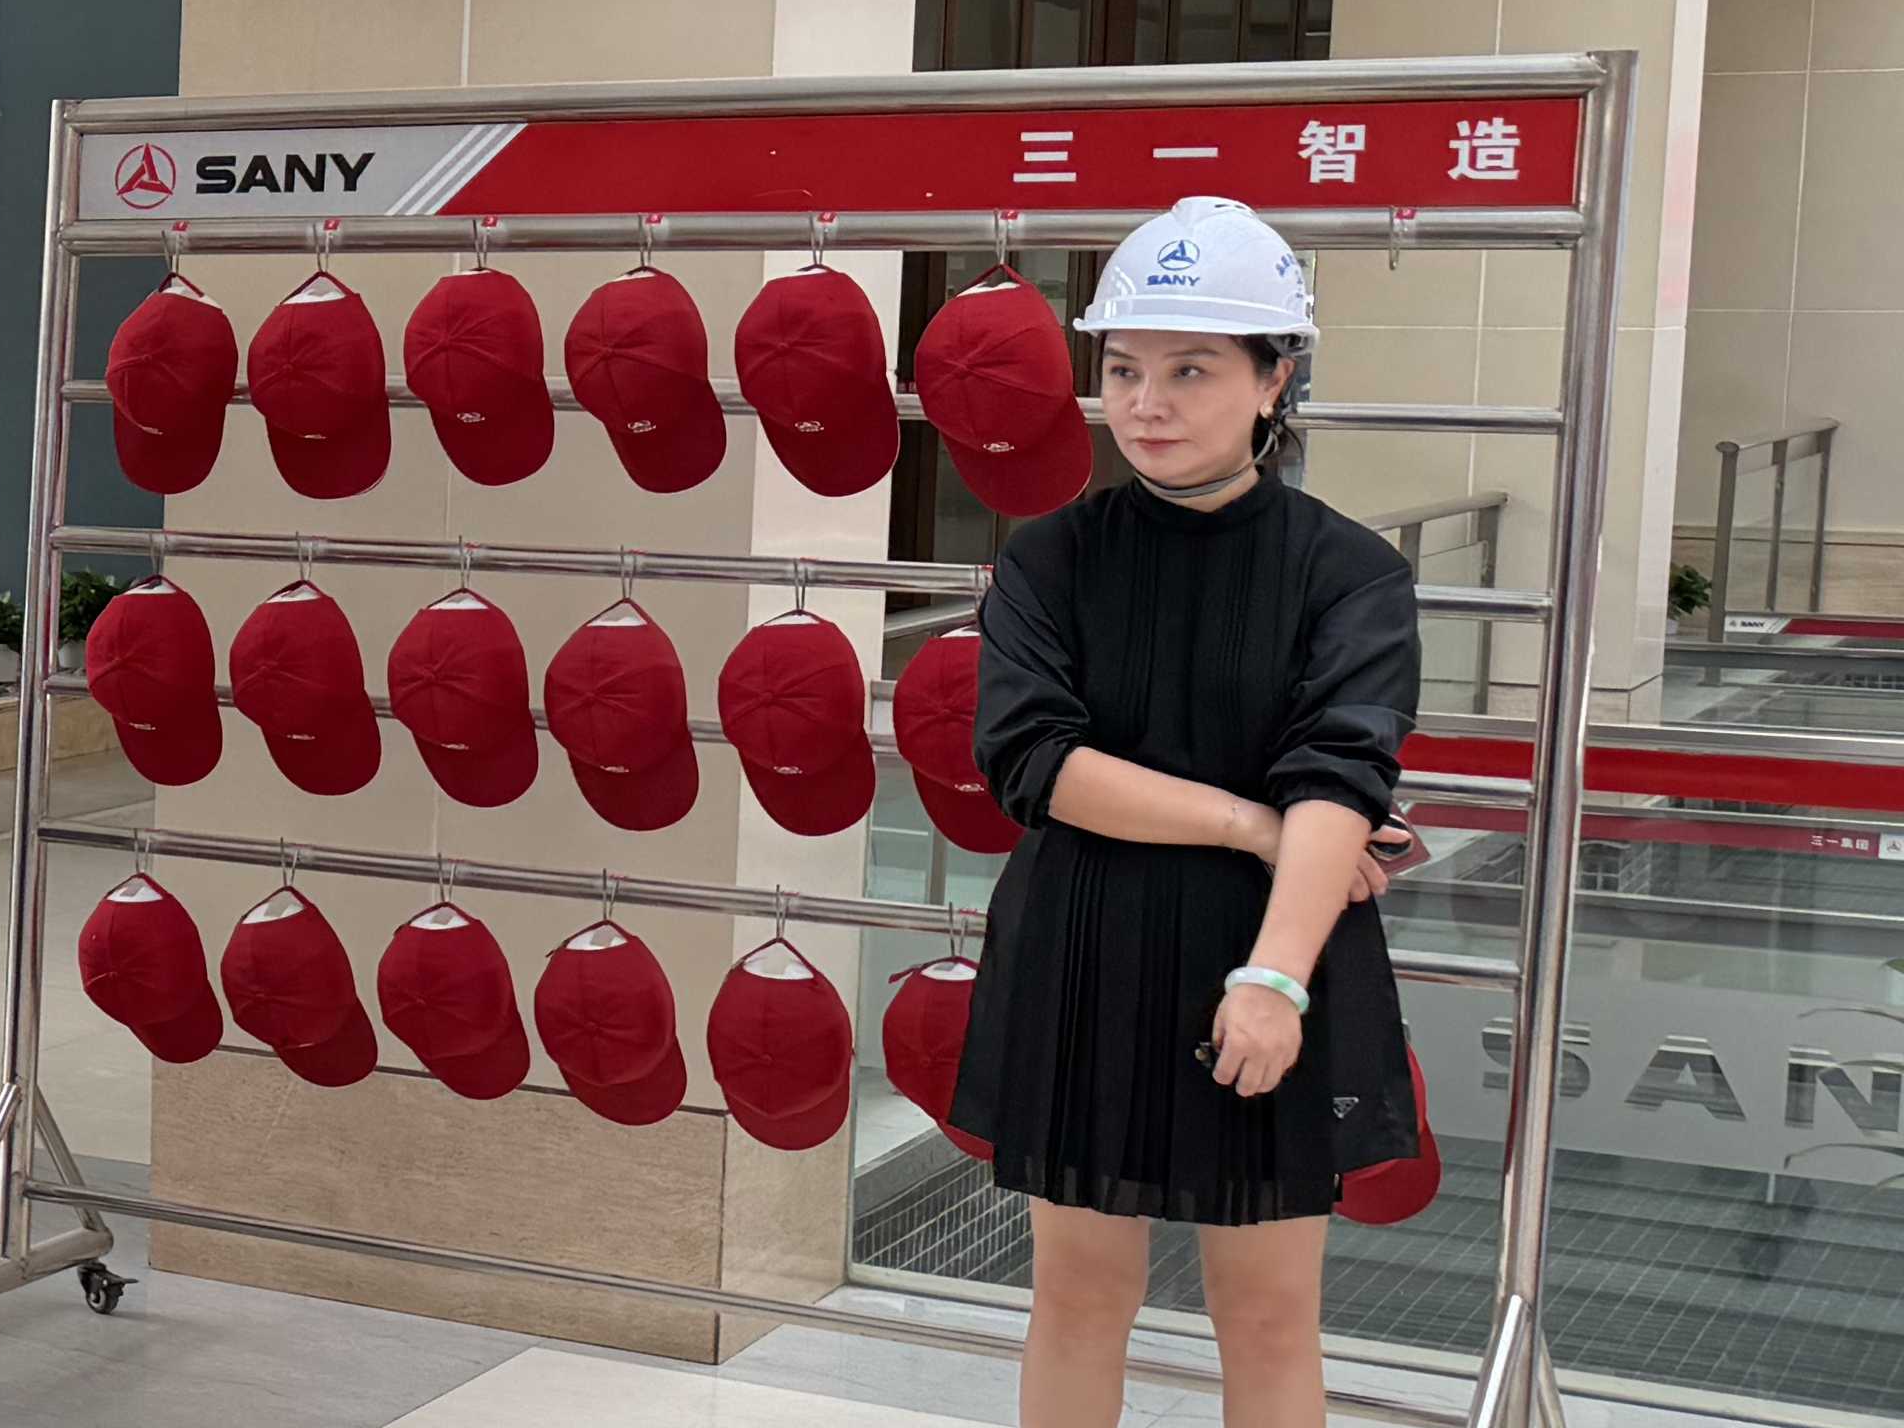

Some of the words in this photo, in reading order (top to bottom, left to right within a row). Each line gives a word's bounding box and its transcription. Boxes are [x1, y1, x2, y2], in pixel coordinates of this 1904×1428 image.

[1012, 117, 1522, 184] 三一智造
[195, 152, 376, 195] SANY
[1146, 274, 1201, 287] SANY
